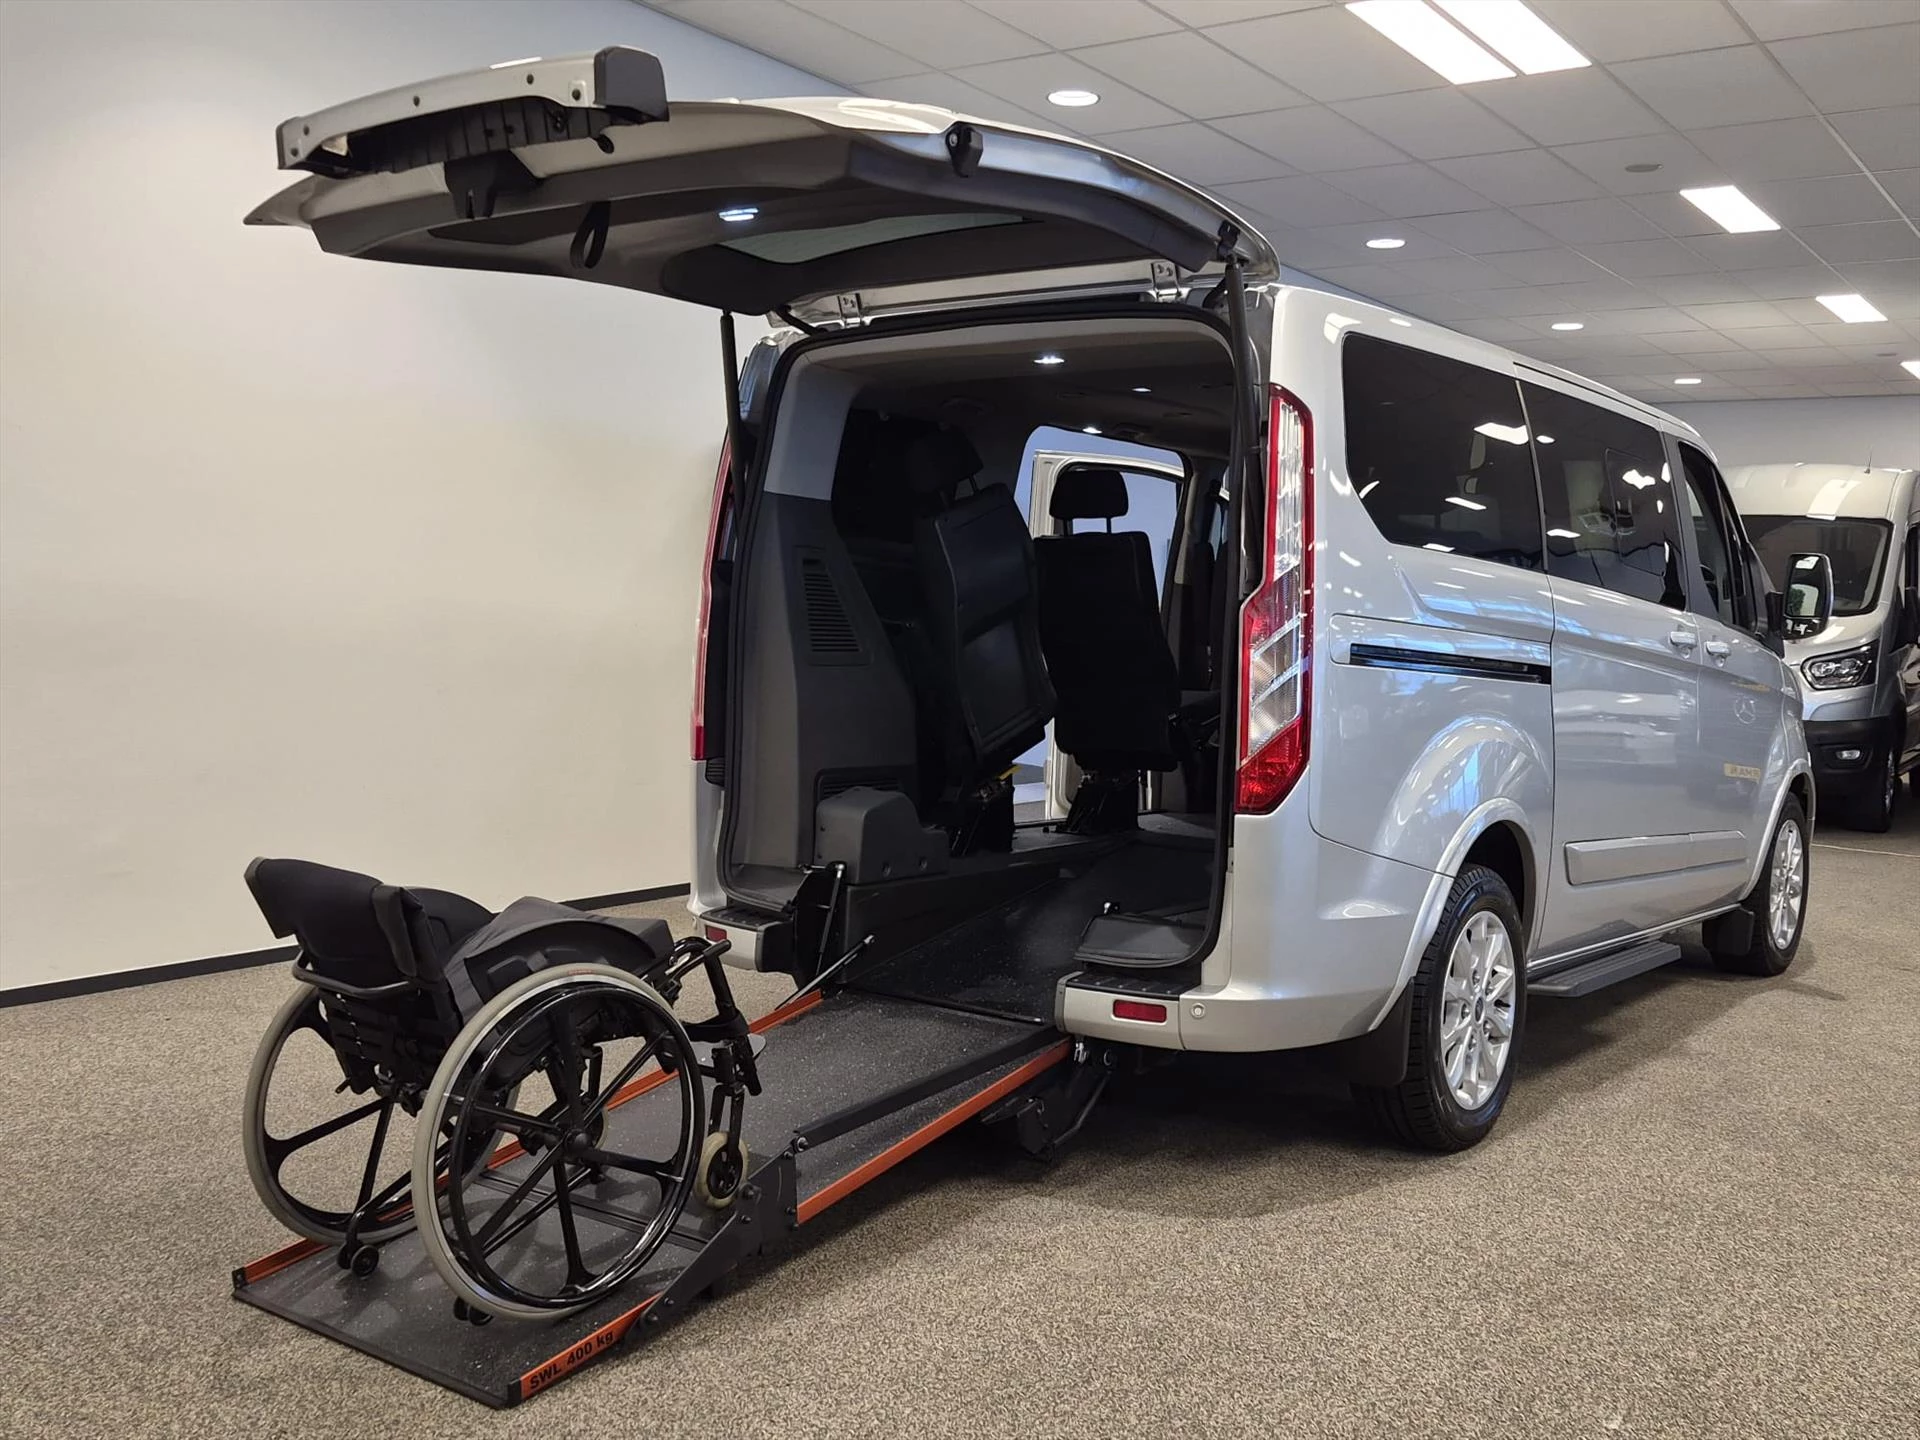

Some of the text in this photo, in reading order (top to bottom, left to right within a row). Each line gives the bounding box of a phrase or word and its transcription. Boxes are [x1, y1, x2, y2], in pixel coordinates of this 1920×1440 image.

[530, 1330, 614, 1389] SWL 400 kg
